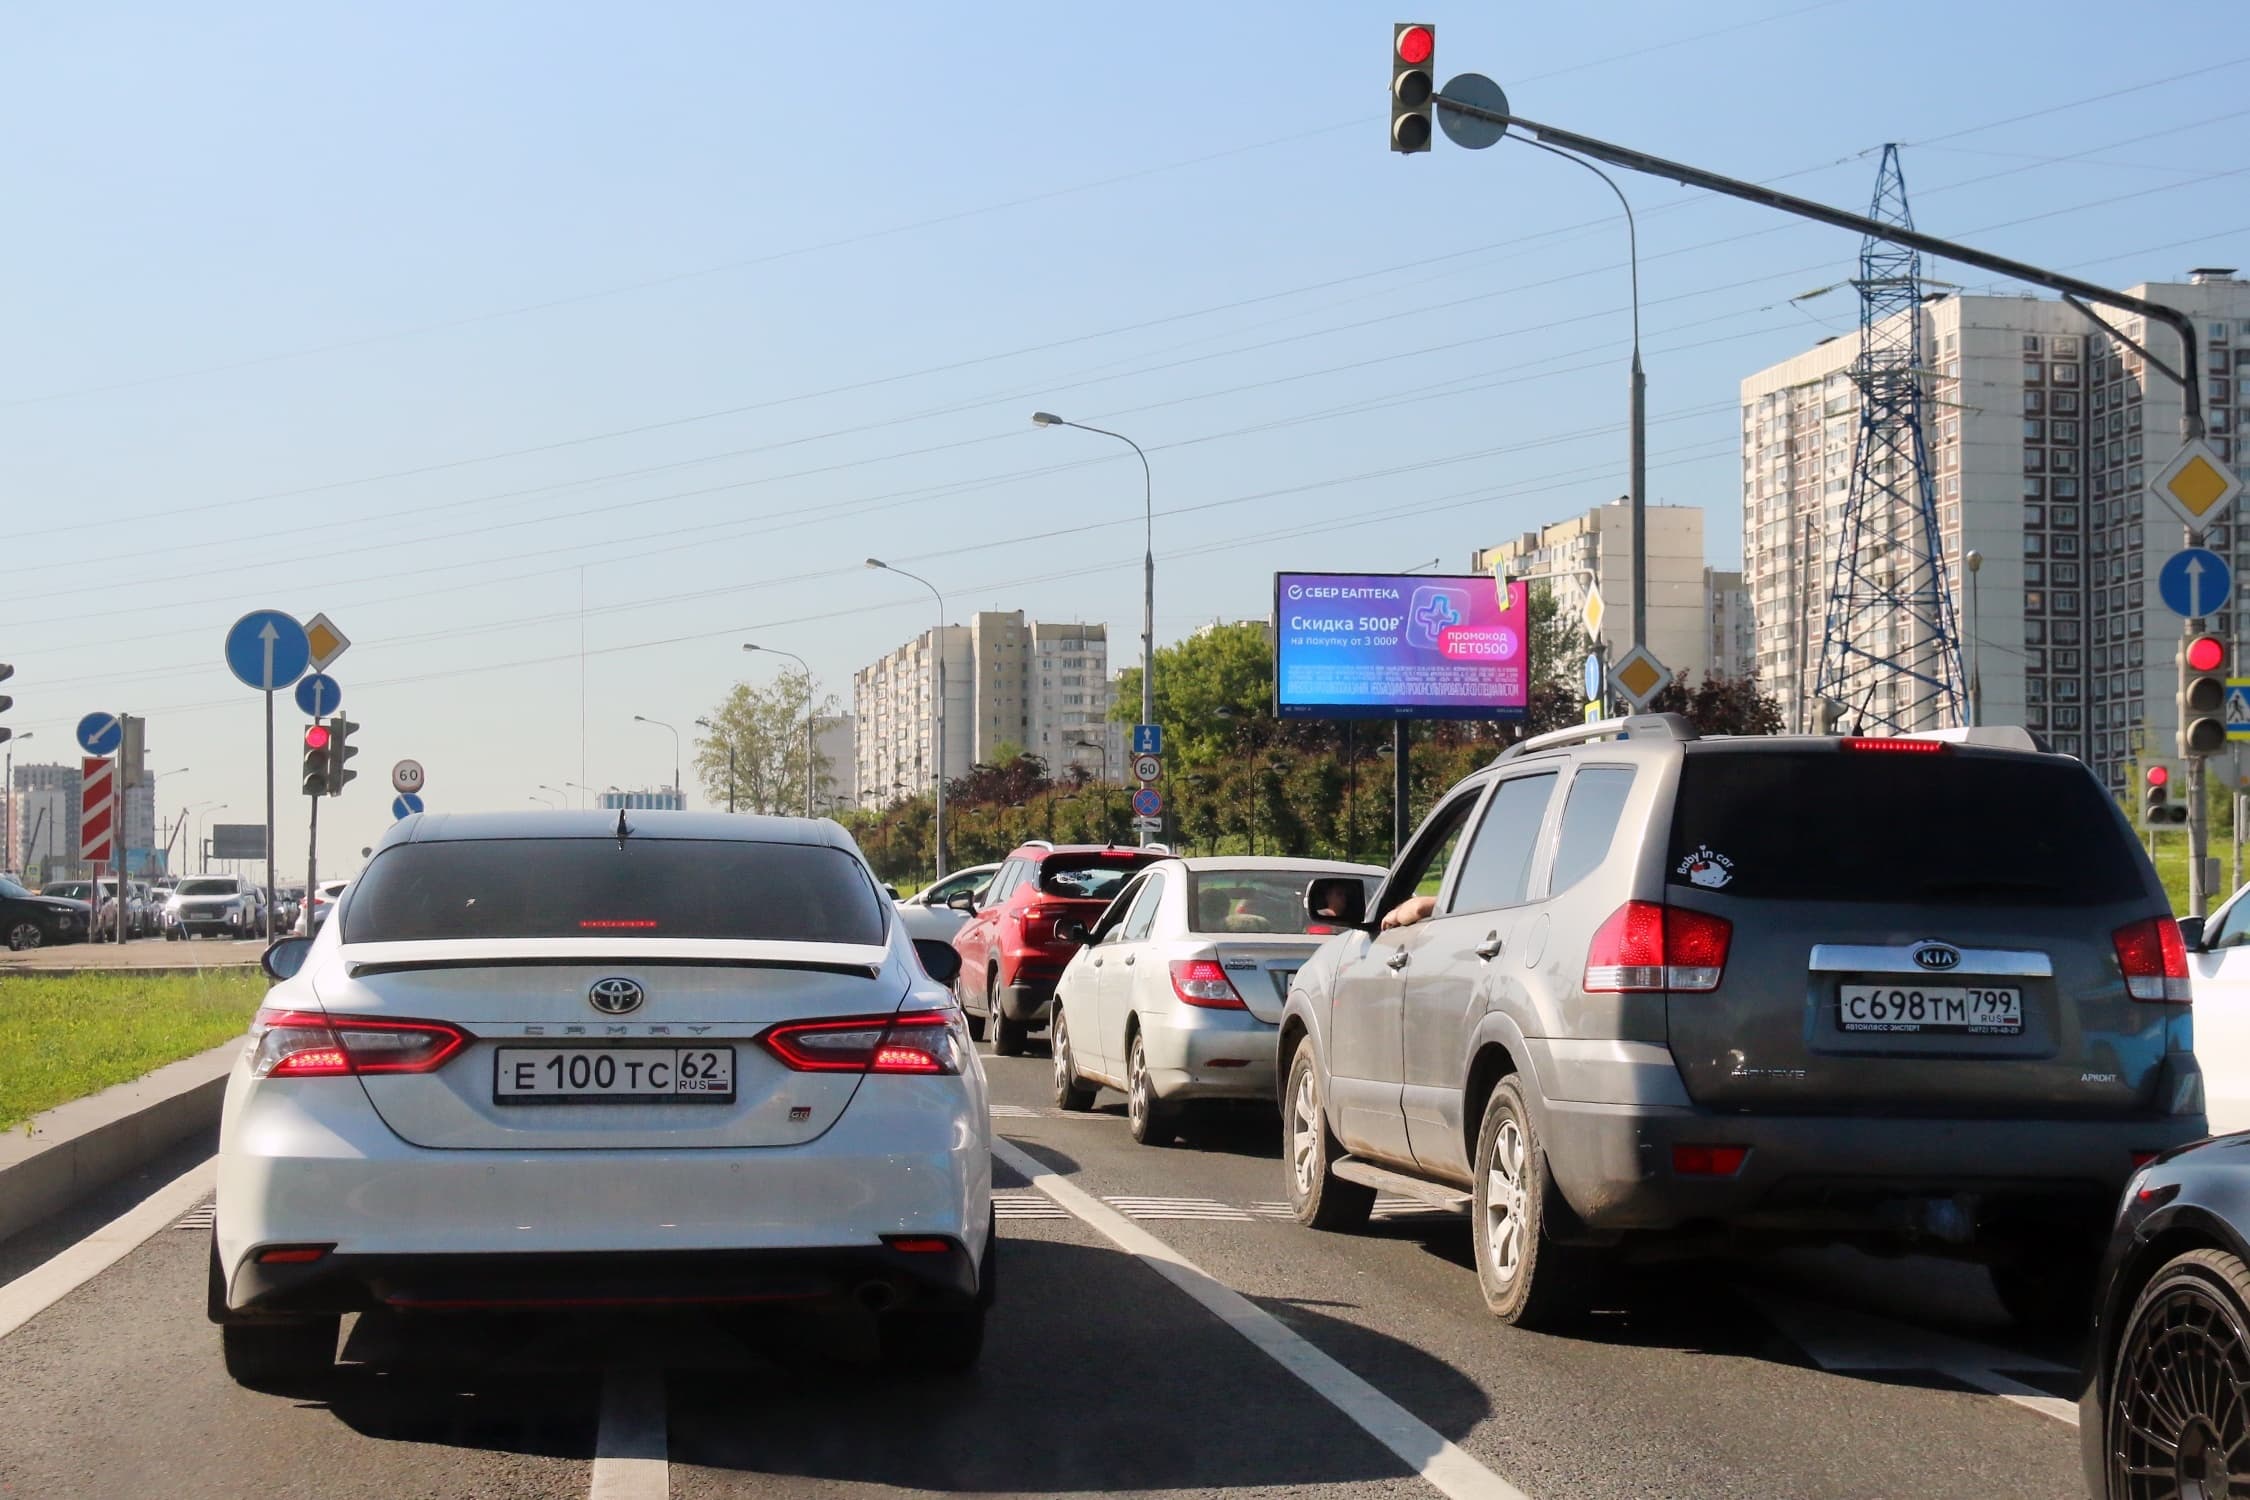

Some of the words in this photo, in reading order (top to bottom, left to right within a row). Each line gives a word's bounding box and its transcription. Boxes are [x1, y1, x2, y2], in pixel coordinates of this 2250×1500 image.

[1305, 587, 1339, 598] СБЕР
[1341, 588, 1400, 600] ЕАПТЕКА
[1291, 616, 1354, 632] Скидка
[1291, 637, 1303, 646] на
[1306, 637, 1348, 647] покупку
[1350, 637, 1362, 646] от
[1447, 631, 1507, 642] промокод
[400, 769, 418, 781] 60
[1140, 763, 1156, 775] 60
[1677, 852, 1700, 874] Baby
[1716, 854, 1734, 868] car
[1922, 952, 1953, 964] KIA
[1968, 991, 2012, 1014] 799
[1981, 1014, 2002, 1023] RUS
[680, 1052, 718, 1080] 62
[679, 1079, 708, 1091] RUS
